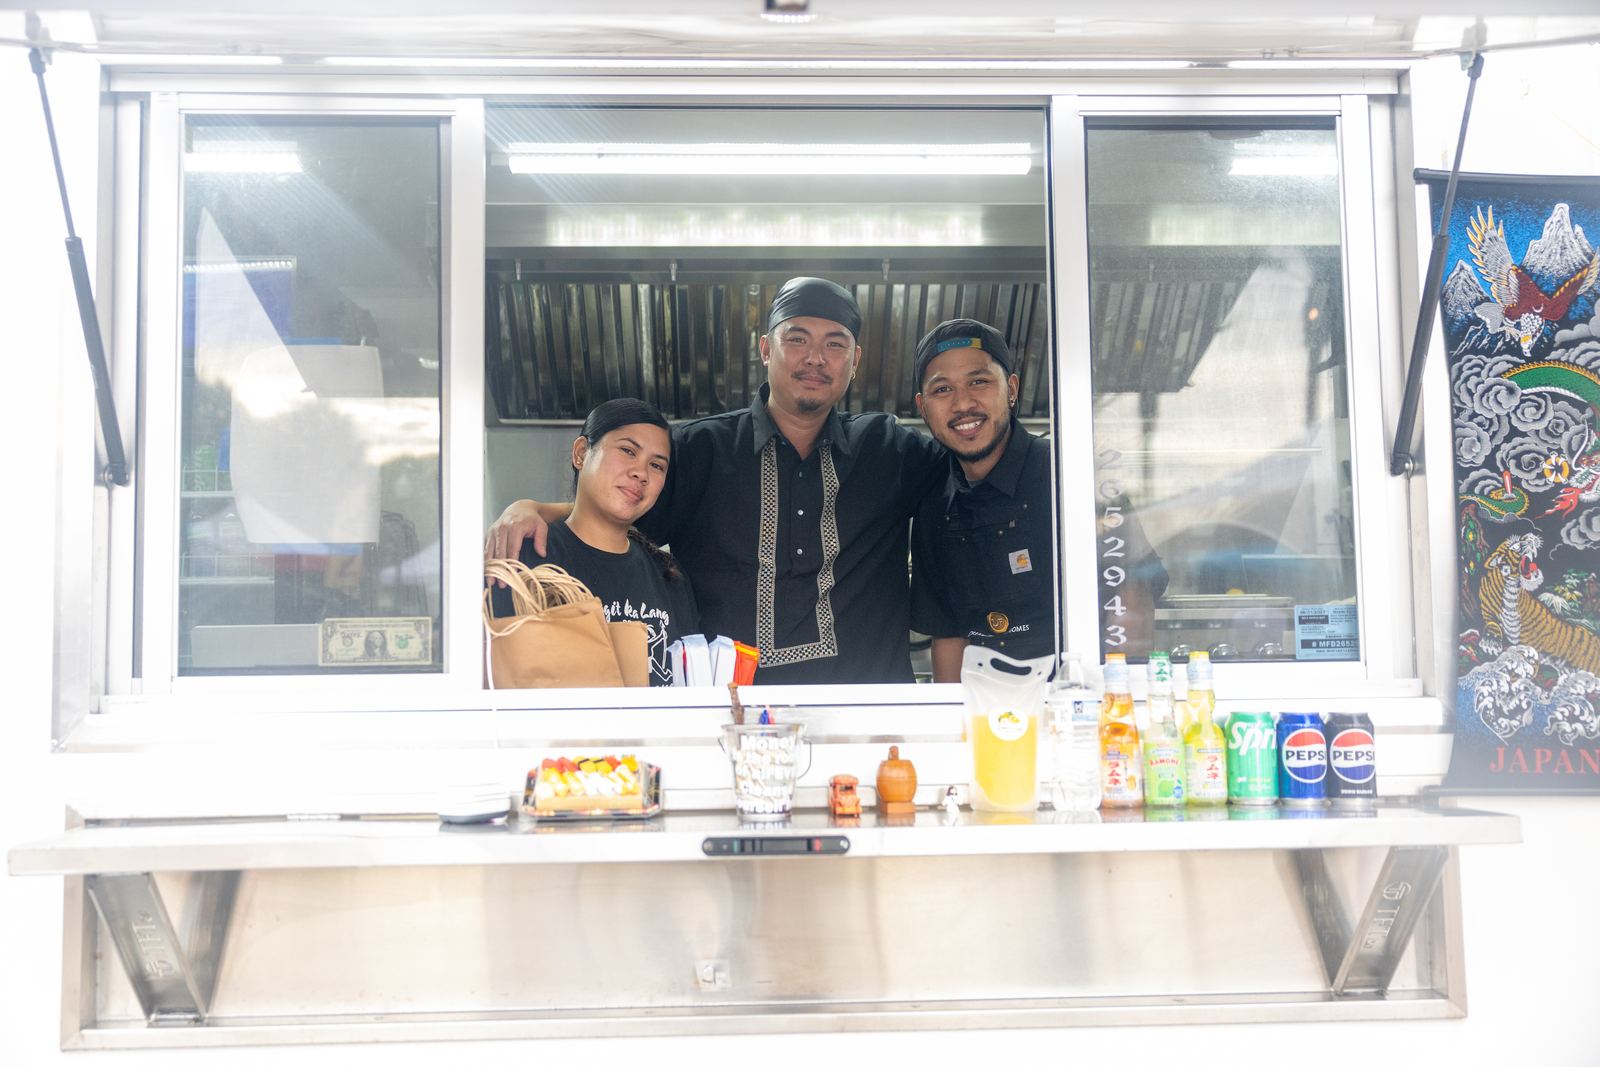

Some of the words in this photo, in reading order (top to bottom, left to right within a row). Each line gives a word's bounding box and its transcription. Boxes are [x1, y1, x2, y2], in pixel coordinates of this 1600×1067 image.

[602, 601, 622, 622] git
[624, 598, 639, 619] ka
[640, 602, 670, 626] Lang
[1009, 624, 1030, 633] OMES
[1489, 747, 1600, 774] JAPAN
